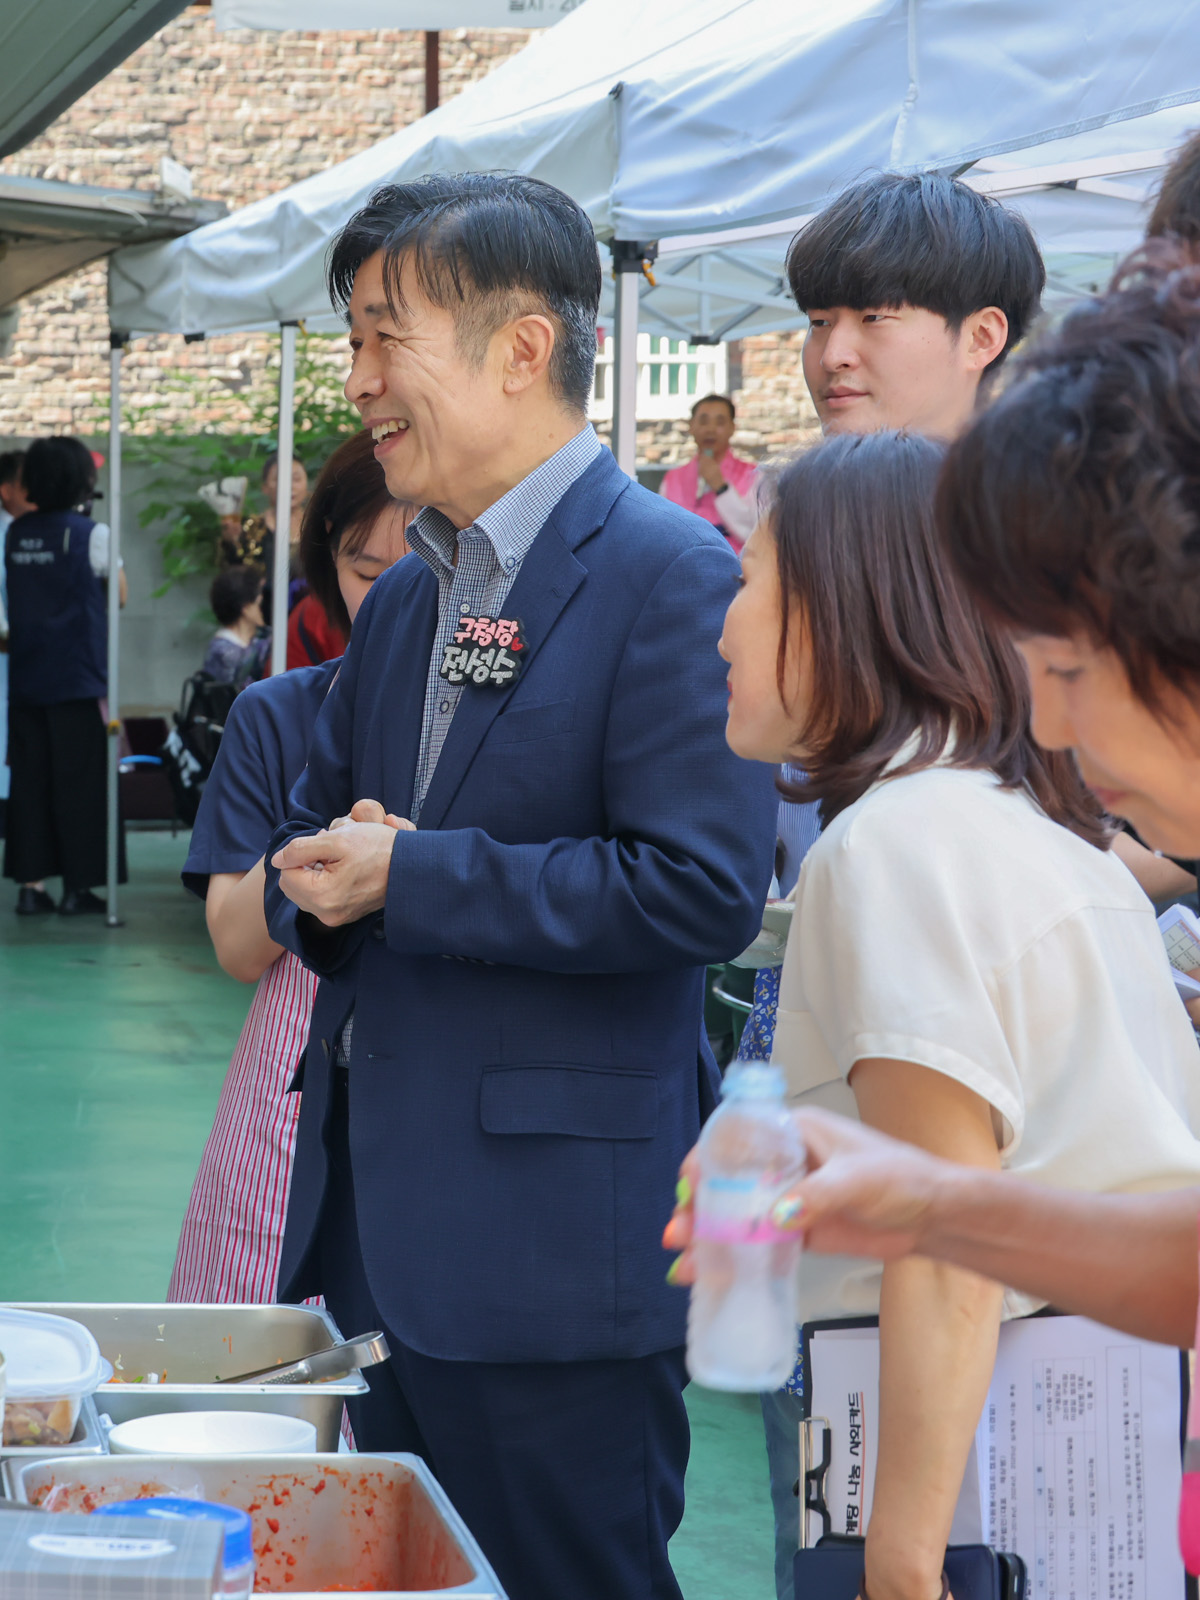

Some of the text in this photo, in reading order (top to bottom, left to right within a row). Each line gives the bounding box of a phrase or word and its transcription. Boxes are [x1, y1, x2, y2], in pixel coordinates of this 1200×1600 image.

[454, 617, 519, 647] 구청장
[440, 646, 516, 684] 전성수
[846, 1464, 860, 1496] 나눔
